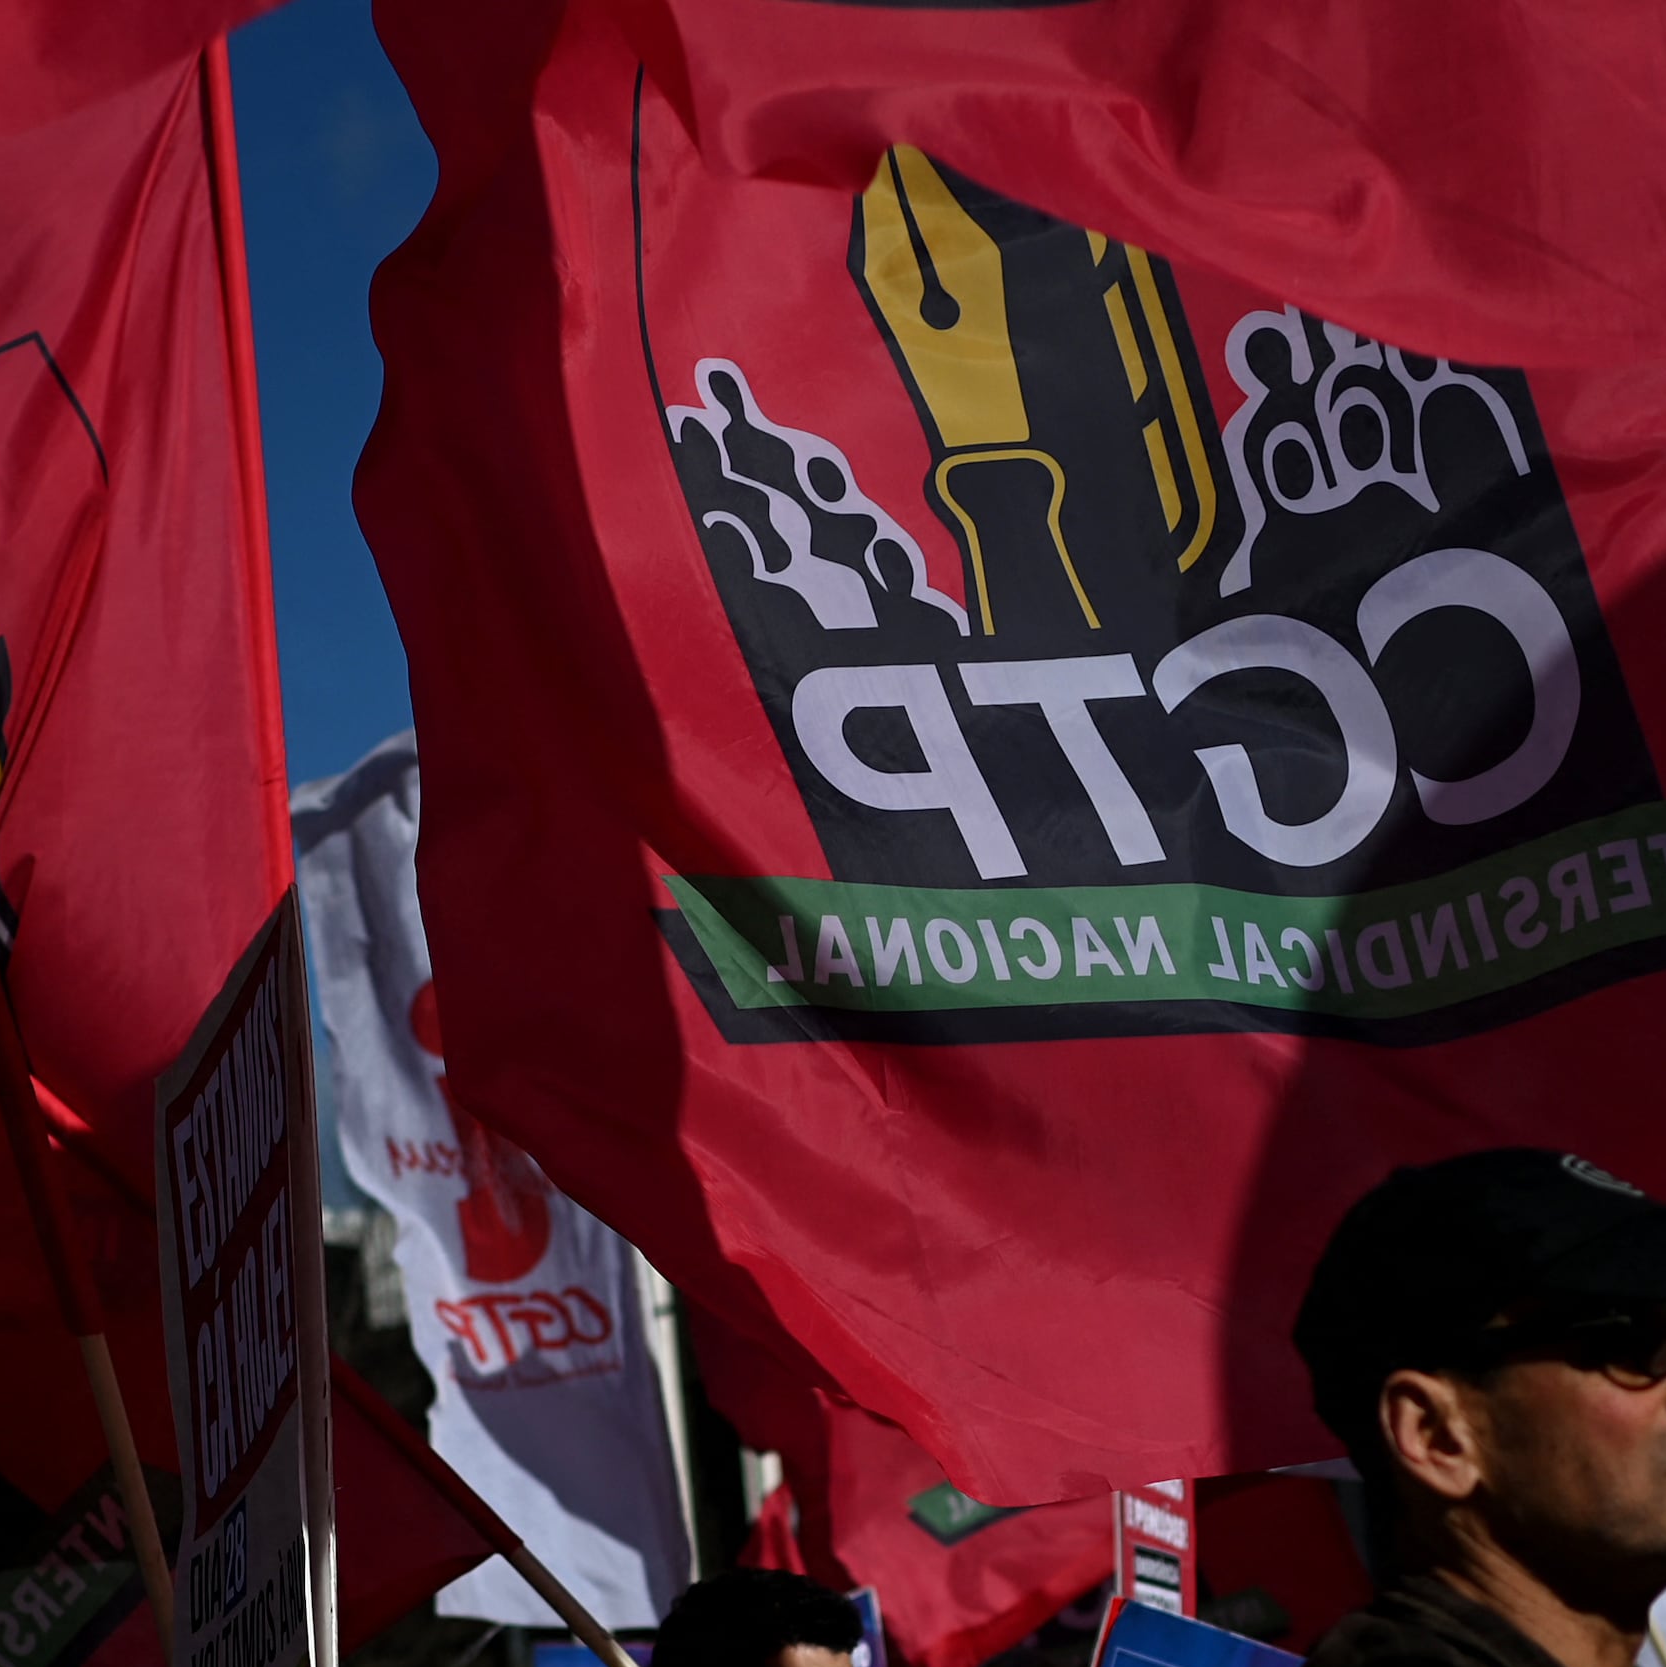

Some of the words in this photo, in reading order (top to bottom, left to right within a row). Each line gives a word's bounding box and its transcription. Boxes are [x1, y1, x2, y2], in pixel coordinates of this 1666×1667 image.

[173, 954, 285, 1284] ESTAMOS
[196, 1266, 239, 1499] CÁ
[233, 1187, 294, 1460] HOJE!
[189, 1538, 222, 1635] DIA
[225, 1508, 247, 1602] 28
[278, 1549, 290, 1652] À
